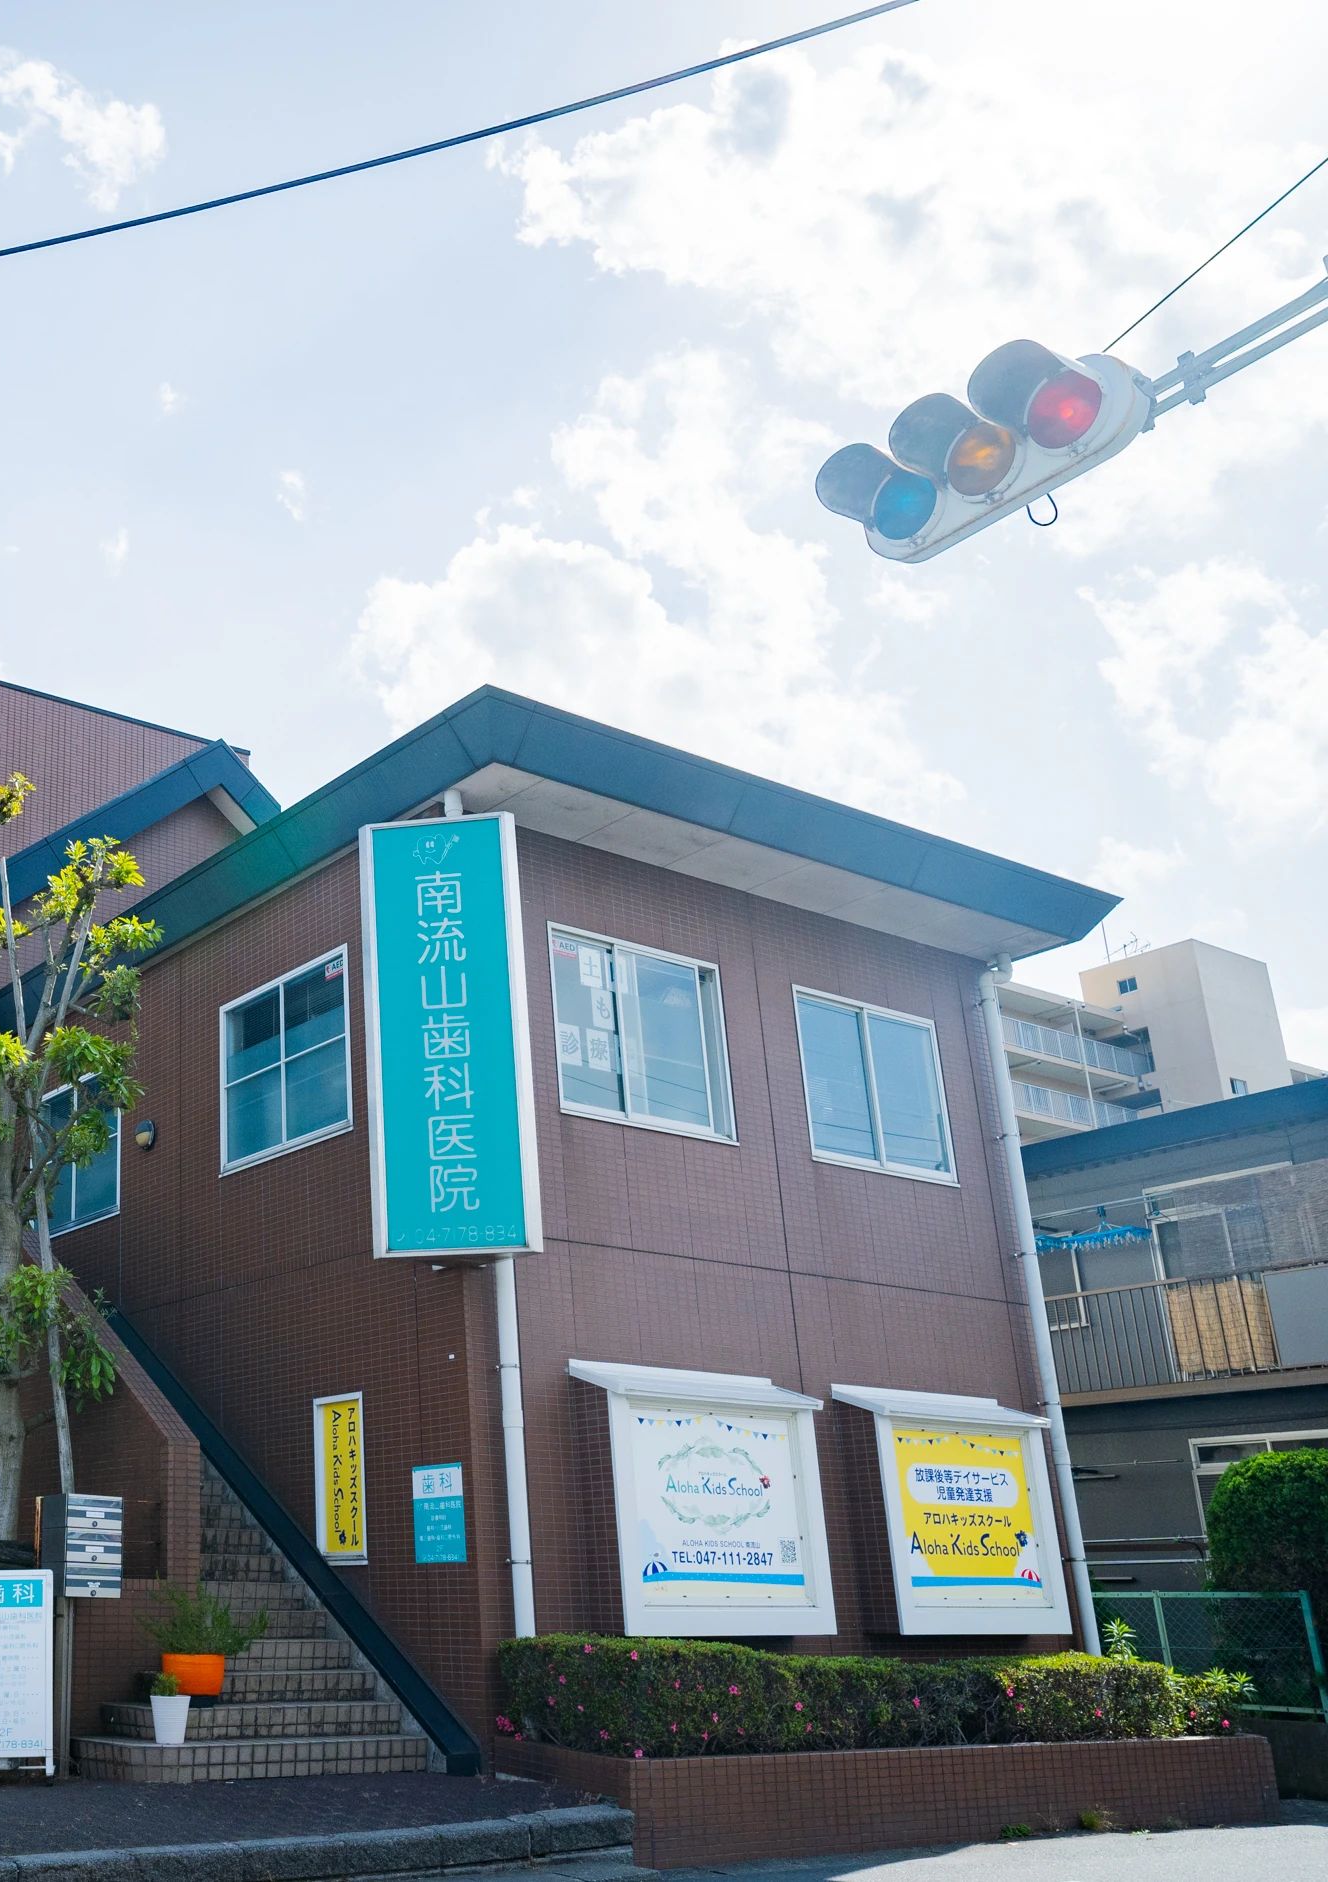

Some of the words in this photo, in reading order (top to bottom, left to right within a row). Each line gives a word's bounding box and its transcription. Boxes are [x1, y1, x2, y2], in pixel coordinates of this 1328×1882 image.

[415, 869, 480, 1213] 南流山歯科医院
[332, 1409, 342, 1450] Aloha
[333, 1454, 343, 1485] Kids
[347, 1407, 360, 1547] アロハキッズスクール
[915, 1467, 1009, 1487] 放課後等デイサービス
[422, 1471, 452, 1494] 歯科
[665, 1474, 700, 1494] Aloha
[701, 1476, 727, 1495] Kids
[727, 1477, 763, 1497] School
[936, 1486, 994, 1503] 児童発達支援
[333, 1488, 344, 1533] School
[923, 1512, 1012, 1528] アロハキッズスクール
[682, 1539, 703, 1547] ALOHA
[719, 1540, 744, 1549] SCHOOL
[911, 1530, 949, 1555] Aloha
[950, 1533, 980, 1556] Kids
[980, 1533, 1020, 1557] School
[672, 1550, 774, 1566] TEL:047-111-2847
[0, 1728, 13, 1737] 2F
